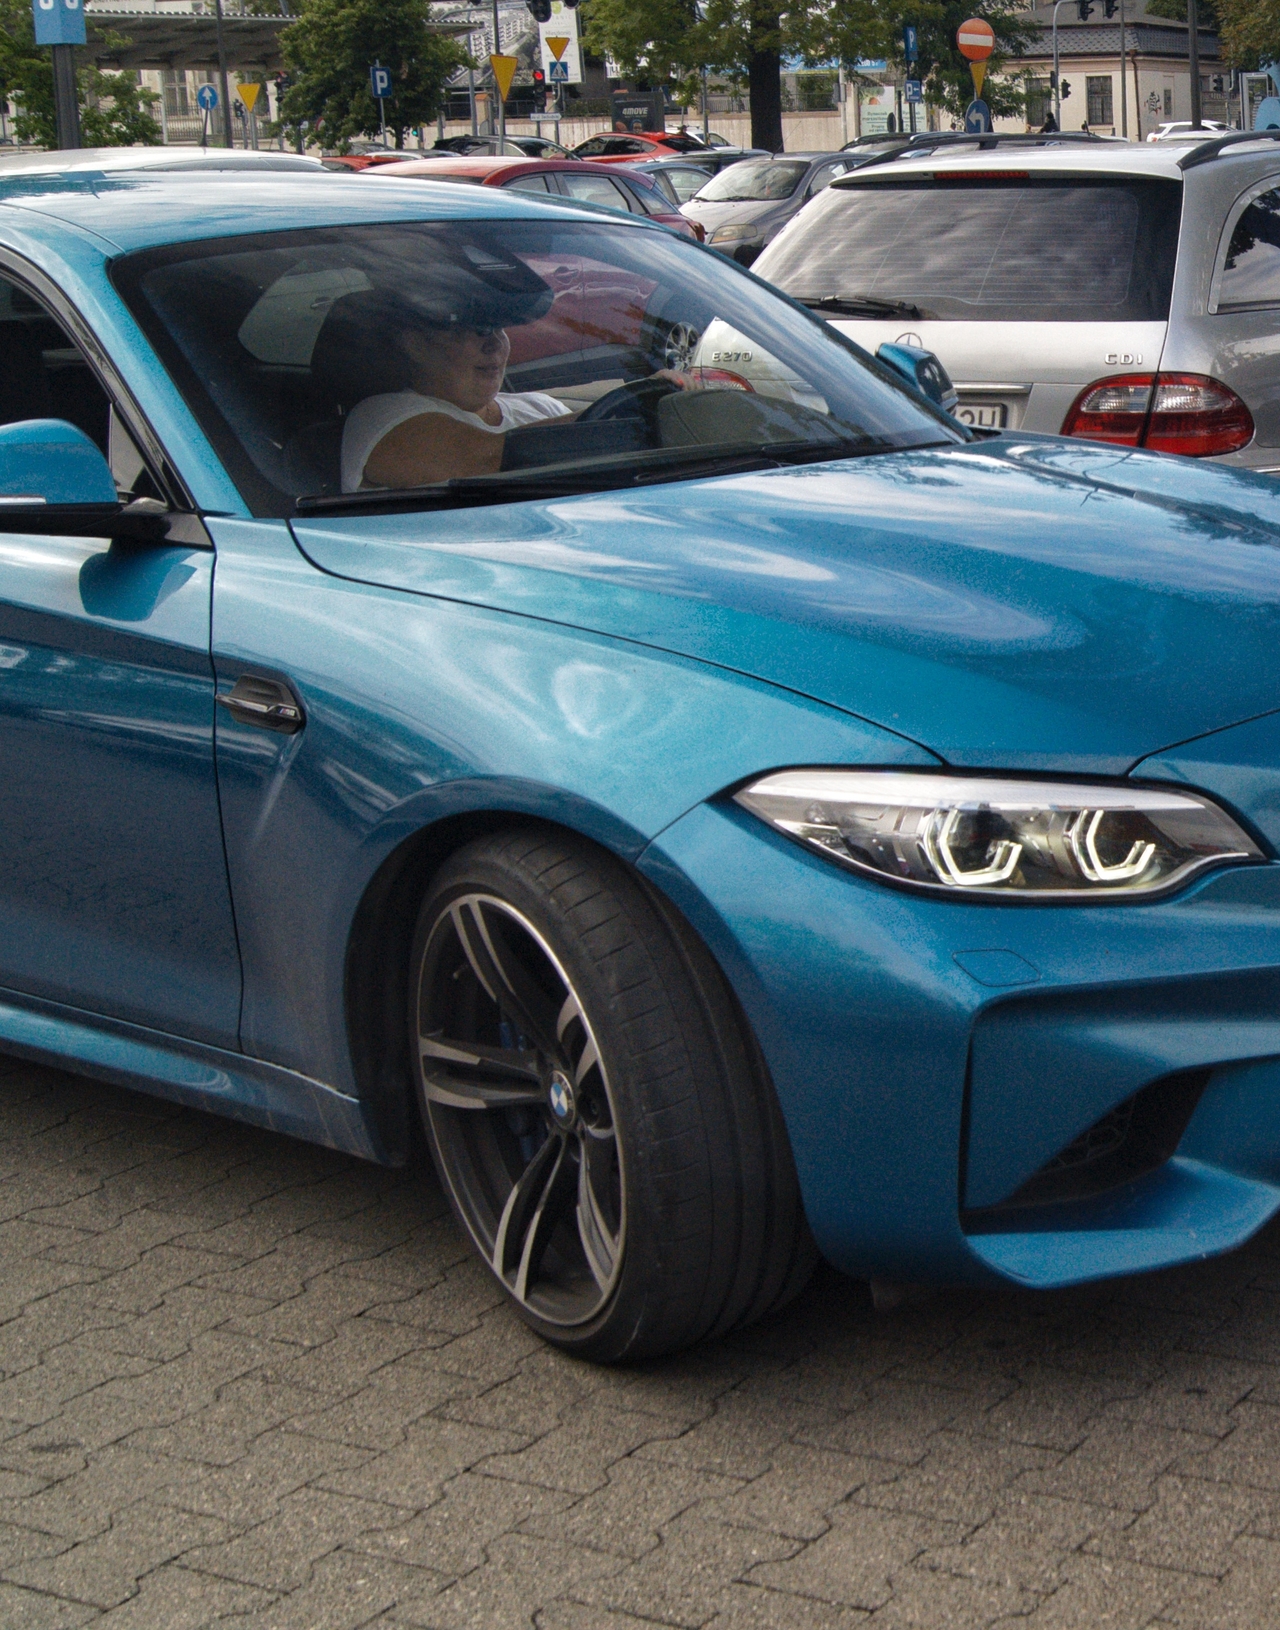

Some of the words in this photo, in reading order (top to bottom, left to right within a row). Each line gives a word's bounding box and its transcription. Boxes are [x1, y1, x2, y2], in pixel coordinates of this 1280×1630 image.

[908, 30, 915, 49] P
[375, 70, 388, 95] P
[905, 83, 913, 99] P
[622, 107, 648, 115] 4MOVE
[1104, 353, 1143, 365] CDI
